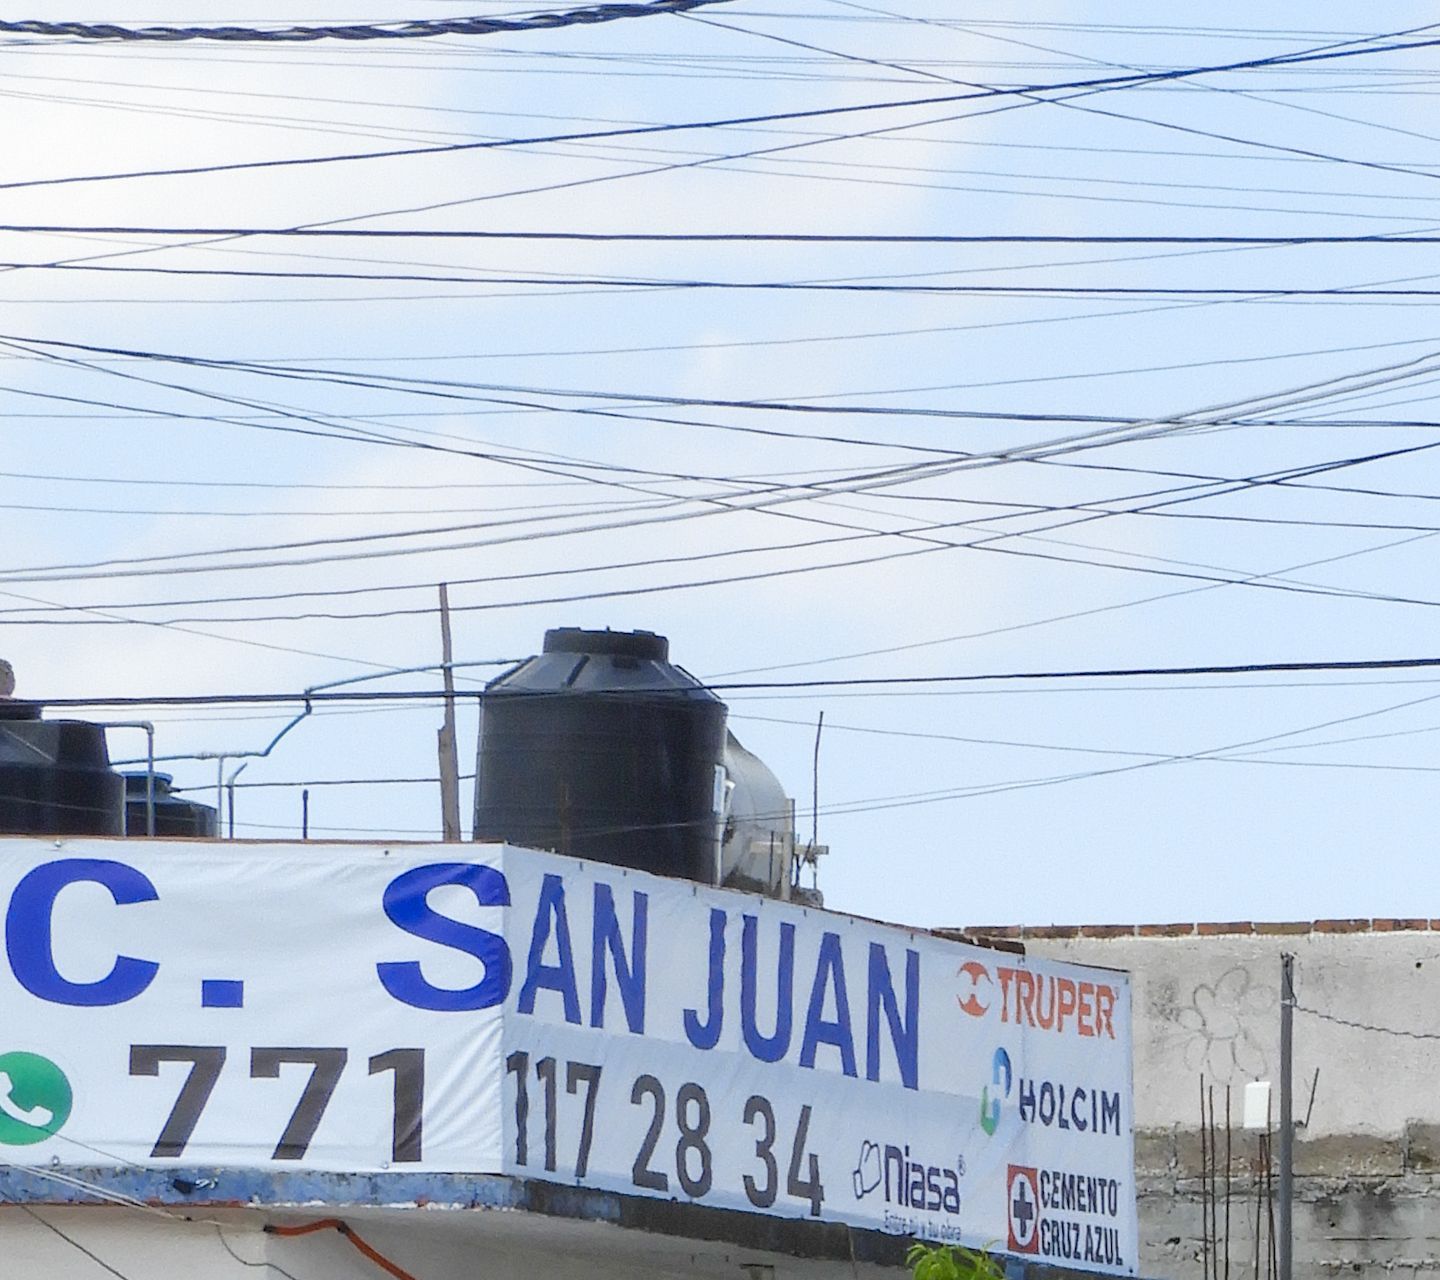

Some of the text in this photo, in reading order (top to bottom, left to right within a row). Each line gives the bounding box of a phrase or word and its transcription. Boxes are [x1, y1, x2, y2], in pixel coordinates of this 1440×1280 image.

[5, 858, 920, 1090] C. SAN JUAN
[996, 966, 1116, 1040] TRUPER
[129, 1044, 824, 1217] 771 117 28 34
[1019, 1078, 1121, 1136] HOLCIM
[1040, 1169, 1118, 1217] CEMENTO
[1040, 1217, 1123, 1266] CRUZ AZUL
